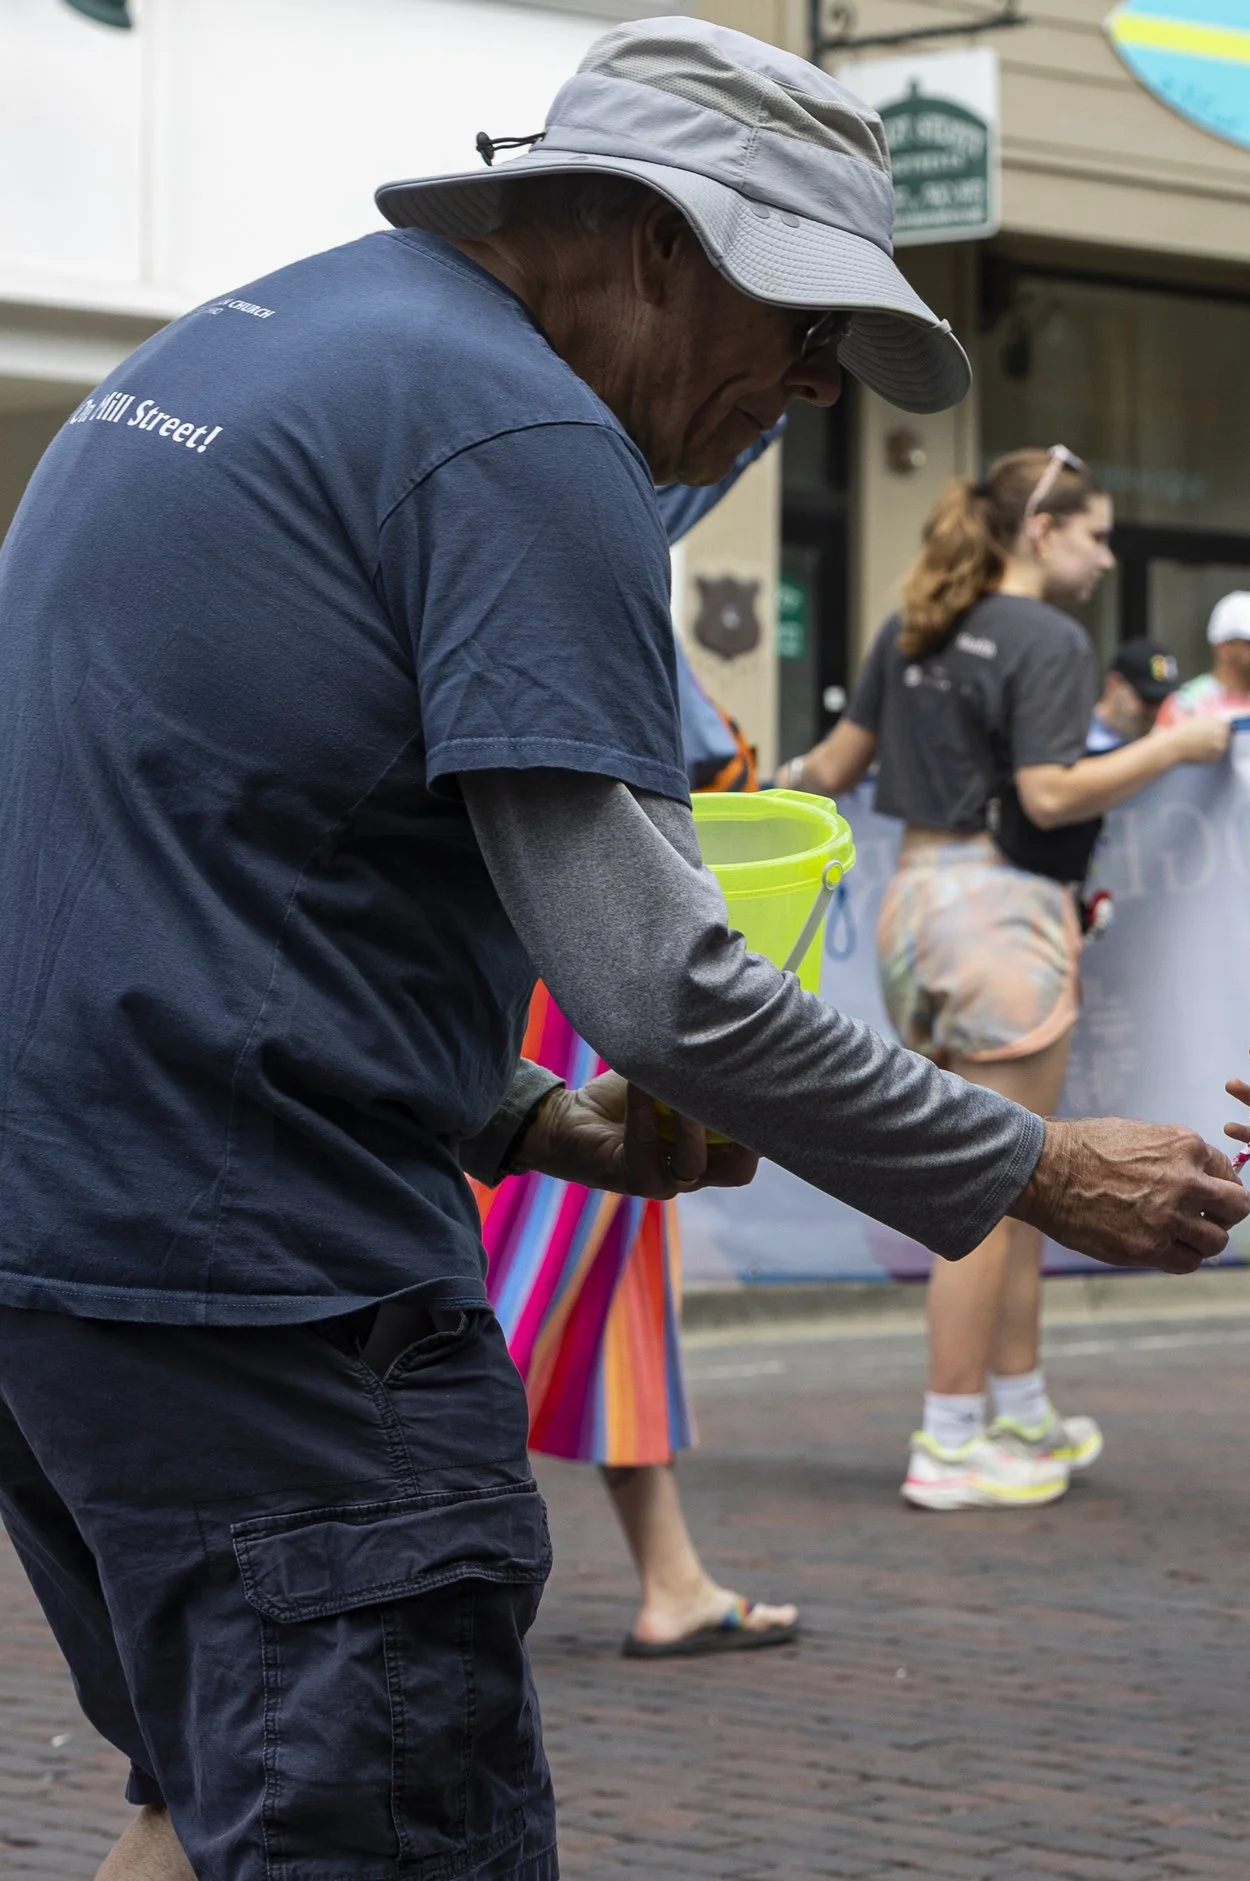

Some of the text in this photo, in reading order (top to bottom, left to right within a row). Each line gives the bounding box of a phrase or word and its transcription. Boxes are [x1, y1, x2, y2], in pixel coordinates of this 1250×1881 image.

[228, 300, 276, 319] CHURCH
[89, 391, 136, 422] Mill
[127, 400, 223, 453] Street!
